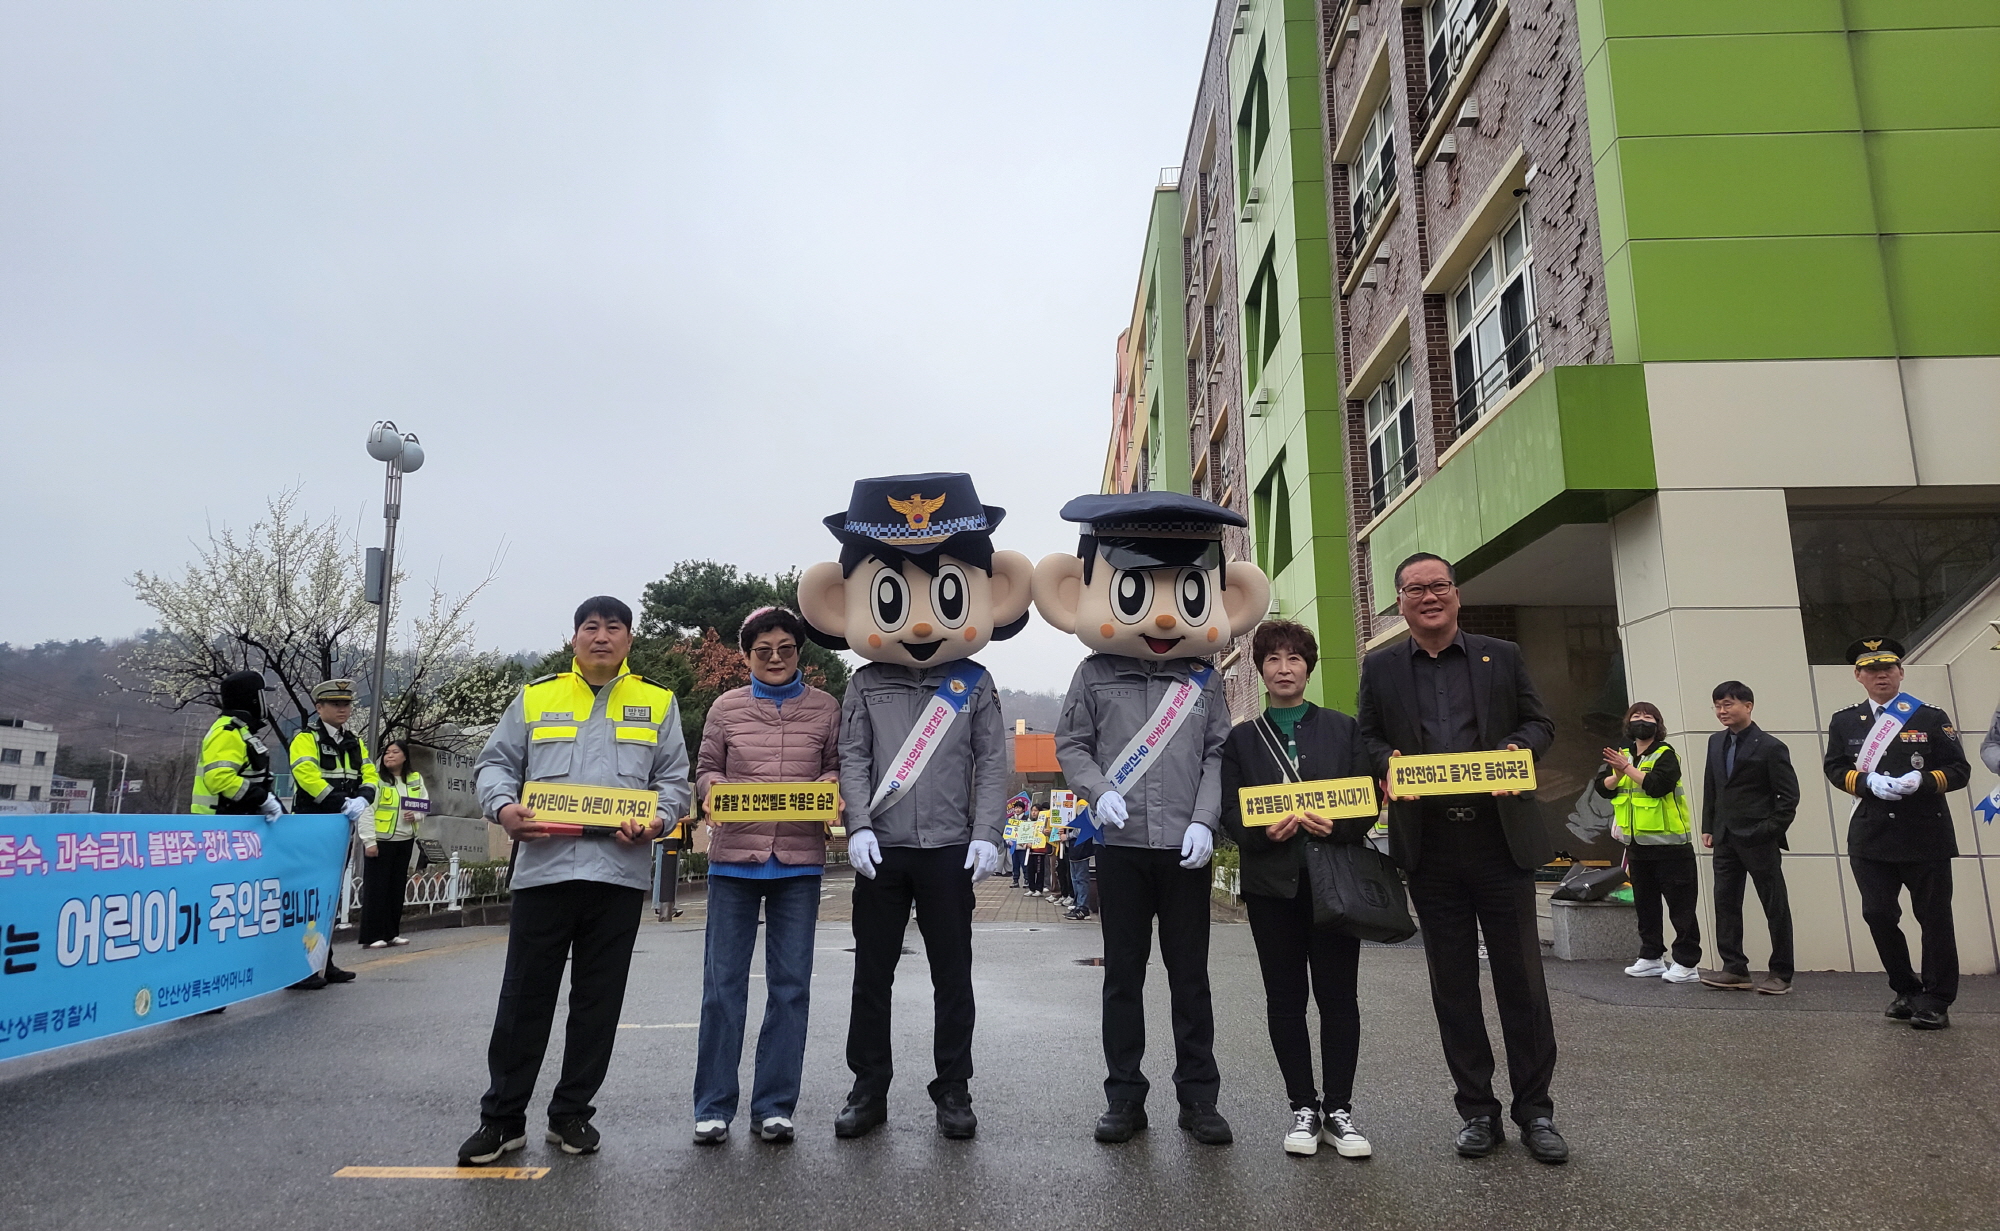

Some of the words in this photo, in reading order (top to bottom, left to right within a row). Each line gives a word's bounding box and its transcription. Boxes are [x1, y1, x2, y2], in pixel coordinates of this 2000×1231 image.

[627, 707, 647, 718] 방범
[922, 706, 948, 739] 안전한
[1146, 706, 1178, 748] 등하굣길
[1874, 719, 1896, 742] 안전한
[453, 753, 476, 768] 생각하
[896, 737, 928, 781] 등하굣길
[1114, 744, 1149, 785] 우리함께
[1396, 764, 1448, 785] #안전하고
[1450, 762, 1483, 783] 즐거운
[1484, 760, 1530, 781] 등하굣길
[526, 792, 579, 813] #어린이는
[581, 796, 614, 815] 어른이
[615, 798, 652, 819] 지켜요!
[714, 794, 739, 812] #출발
[741, 793, 750, 811] 전
[752, 793, 787, 811] 안전벨트
[789, 792, 815, 811] 착용은
[817, 792, 834, 810] 습관
[1246, 794, 1293, 815] #점멸등이
[1295, 791, 1326, 810] 켜지면
[1326, 787, 1371, 808] 잠시대기!
[56, 832, 145, 872] 과속금지,
[0, 923, 40, 975] 는
[56, 886, 201, 968] 어린이가
[207, 877, 321, 943] 주인공입니다.
[158, 967, 254, 1008] 안산상록녹색어머니회
